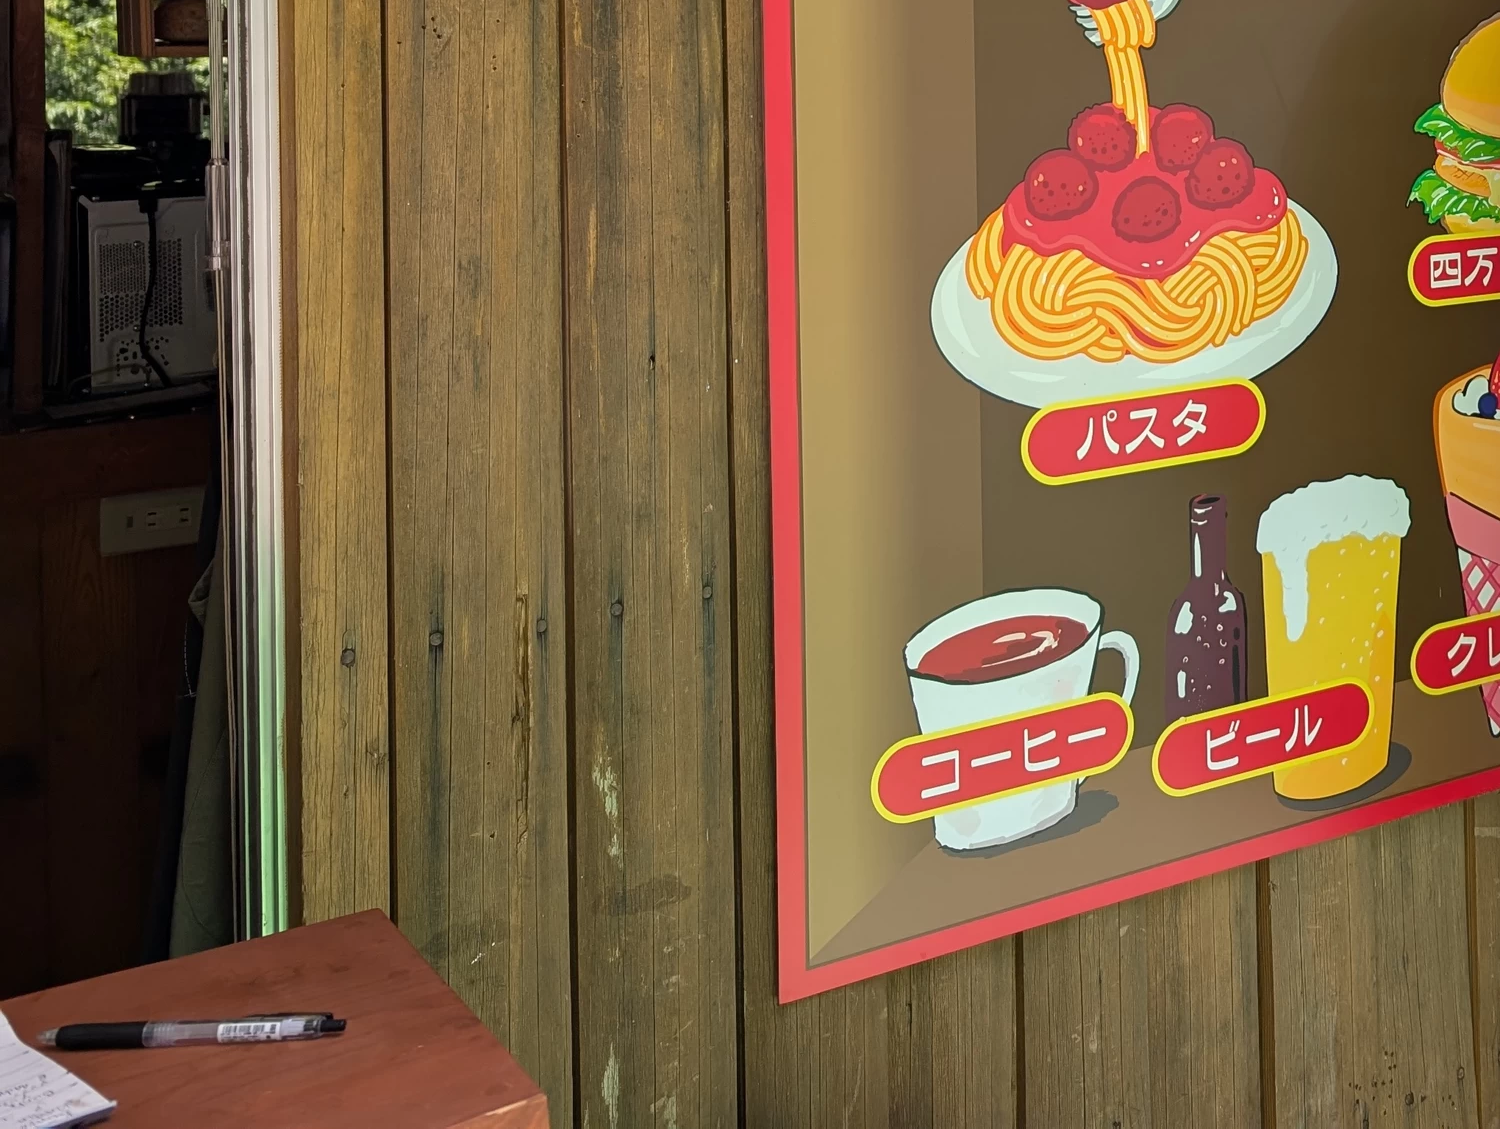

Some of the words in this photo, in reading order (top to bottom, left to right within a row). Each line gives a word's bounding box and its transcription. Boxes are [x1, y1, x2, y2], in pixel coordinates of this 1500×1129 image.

[1075, 399, 1210, 461] パスタ
[920, 725, 1108, 801] コーヒー
[1206, 702, 1323, 771] ビール
